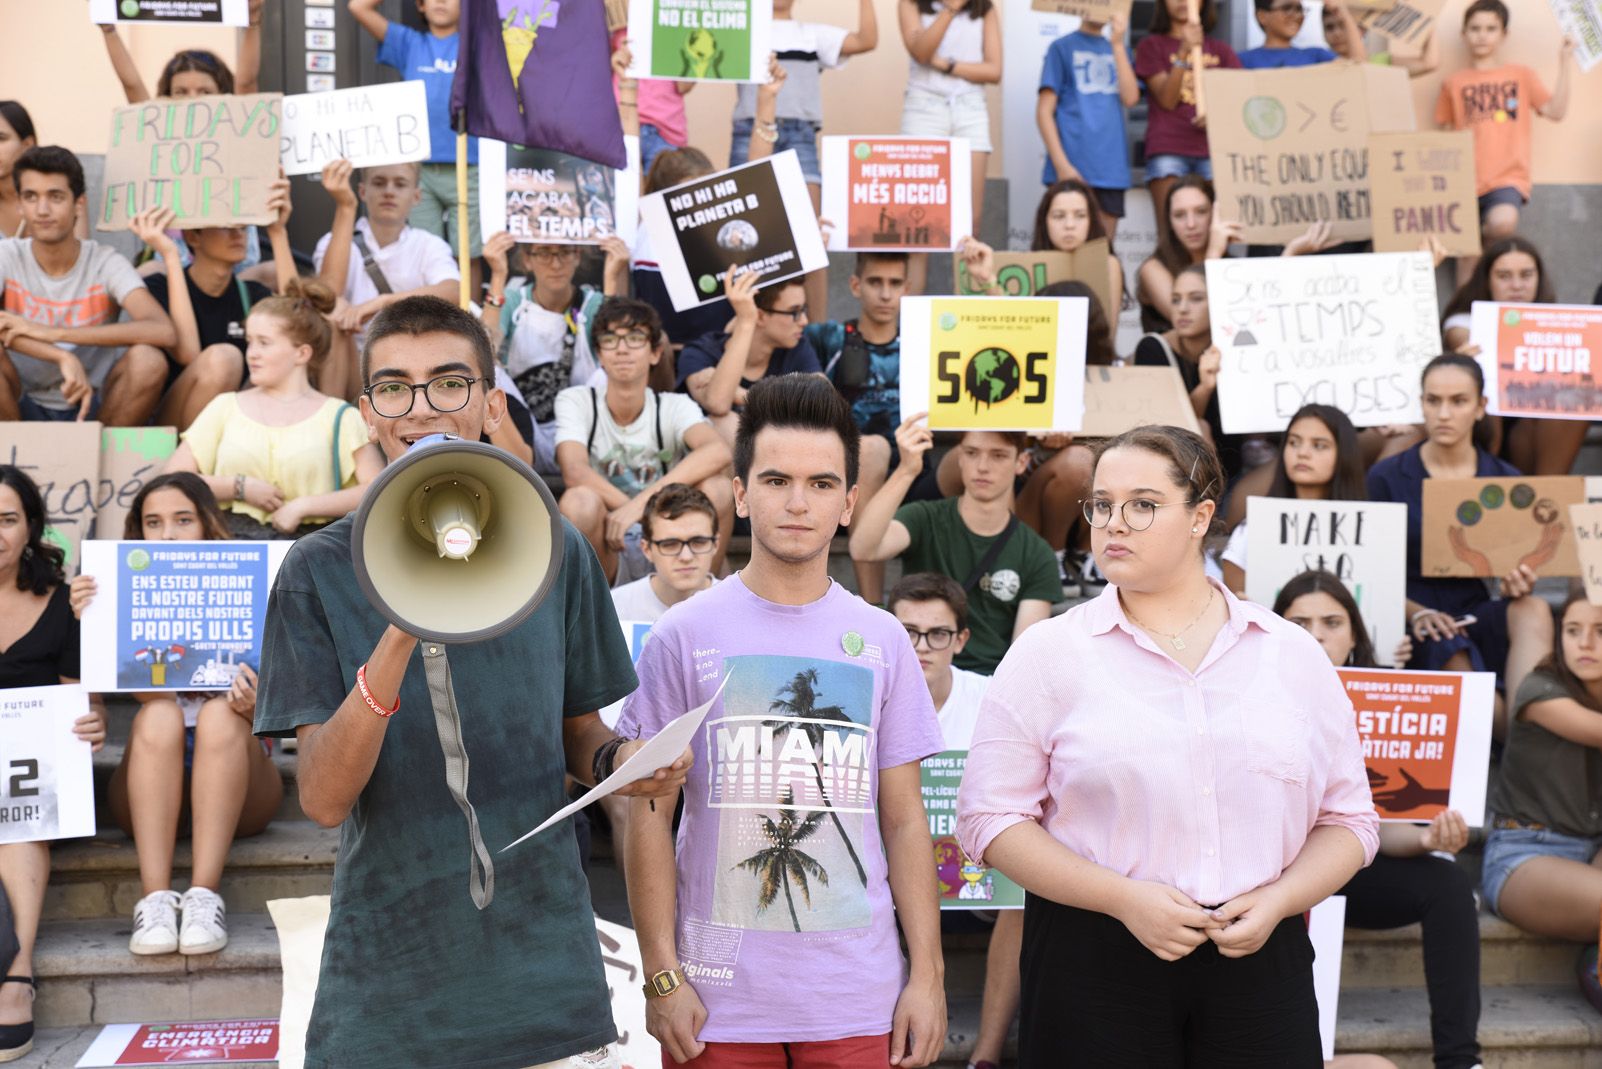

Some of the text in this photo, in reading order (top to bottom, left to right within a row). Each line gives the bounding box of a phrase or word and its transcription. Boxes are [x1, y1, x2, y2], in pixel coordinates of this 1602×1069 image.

[658, 9, 747, 29] NO EL CLIMA
[112, 99, 281, 148] FRIDAYS
[279, 113, 421, 163] PLANETA B
[150, 140, 224, 176] FOR
[1227, 152, 1272, 186] THE
[1277, 151, 1325, 185] ONLY
[104, 176, 260, 224] FUTURE
[509, 190, 573, 208] ACABA
[669, 179, 738, 212] NO HI HA
[853, 177, 947, 205] MÉS ACCIÓ
[675, 198, 746, 232] PLANETA
[1237, 194, 1265, 226] YOU
[1271, 191, 1331, 226] SHOULD
[1393, 202, 1463, 234] PANIC
[509, 214, 609, 238] EL TEMPS
[1267, 300, 1385, 342] TEMPS
[1514, 345, 1591, 374] FUTUR
[1279, 510, 1367, 546] MAKE
[153, 552, 261, 561] FRIDAYS FOR FUTURE
[131, 575, 254, 589] ENS ESTEU ROBANT
[132, 591, 253, 606] EL NOSTRE FUTUR
[131, 607, 253, 619] DAVANT DELS NOSTRES
[131, 620, 253, 641] PROPIS ULLS
[357, 675, 369, 699] GAME
[4, 700, 44, 710] FUTURE
[366, 697, 386, 716] OVER
[1414, 741, 1444, 760] JA!
[142, 1034, 271, 1049] CLIMÀTICA
[147, 1028, 273, 1040] EMERGÈNCIA
